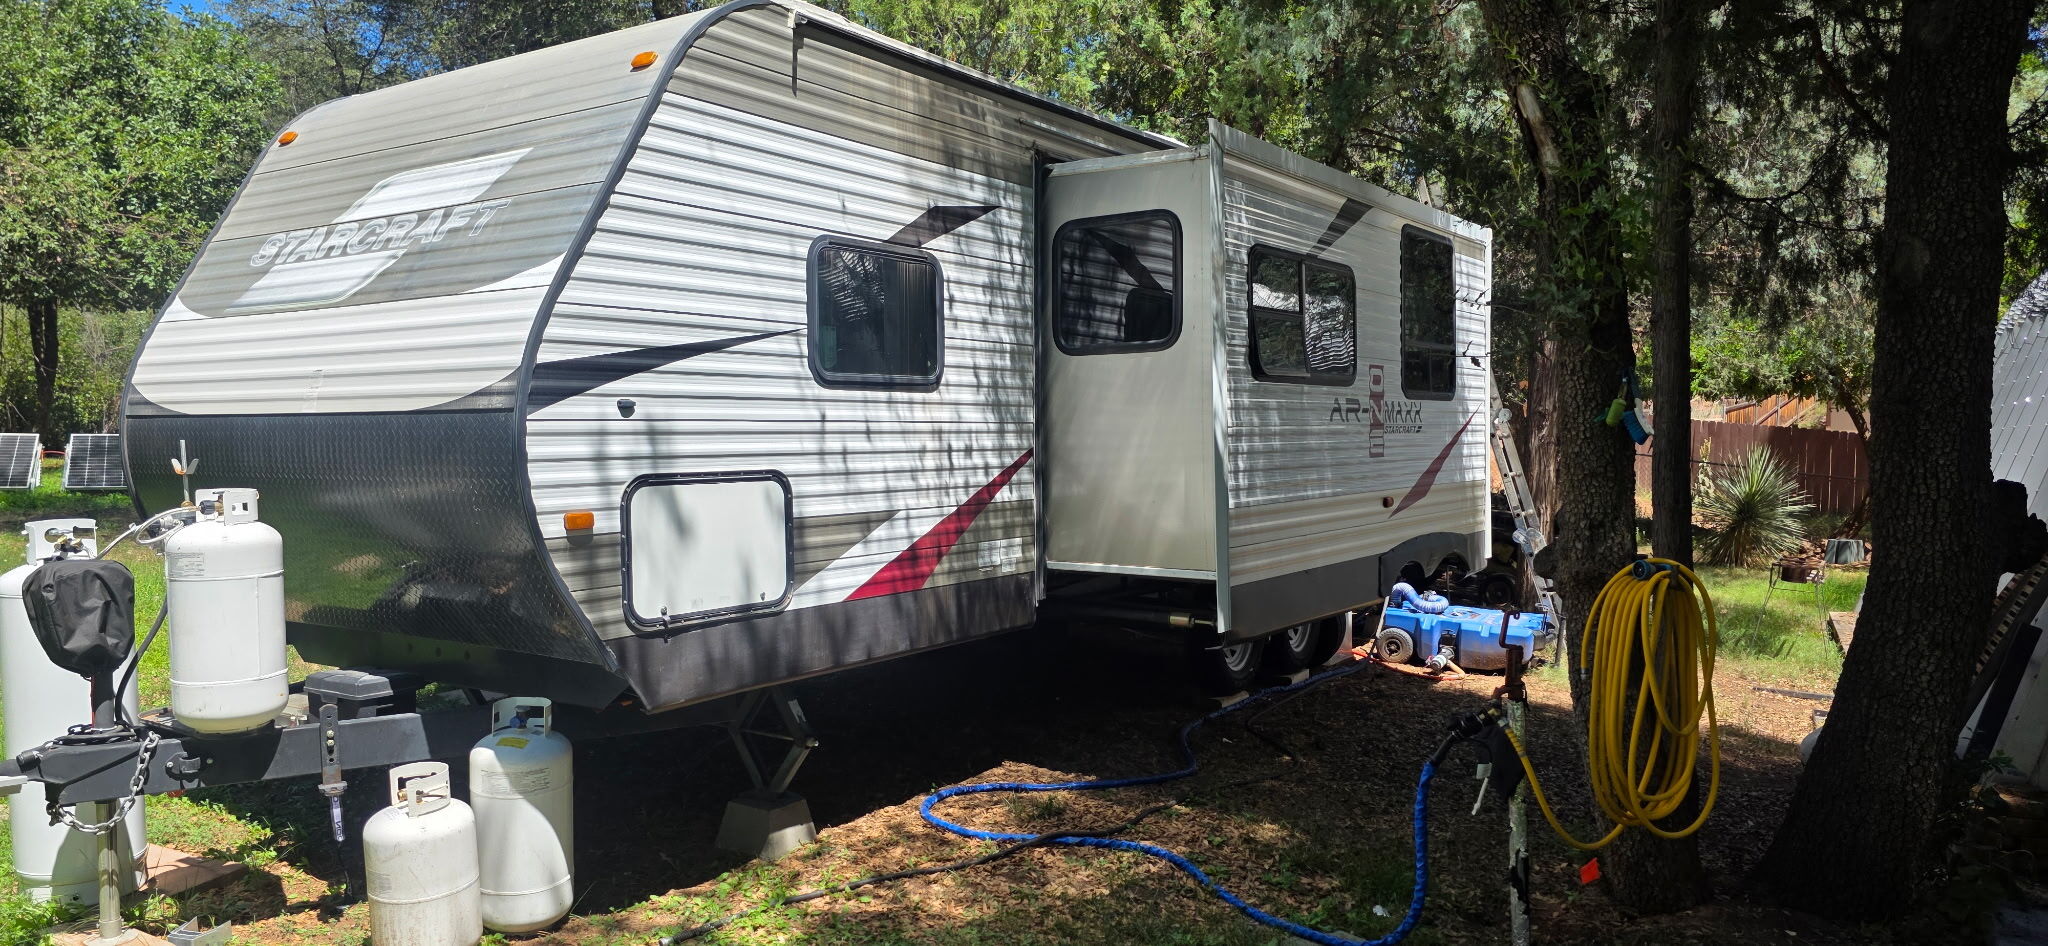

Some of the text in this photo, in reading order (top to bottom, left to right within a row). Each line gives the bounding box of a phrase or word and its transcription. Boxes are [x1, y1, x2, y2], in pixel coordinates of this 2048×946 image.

[250, 200, 513, 267] STARCRAFT
[1384, 400, 1422, 423] MAXX
[1384, 425, 1416, 434] STARCRAFT
